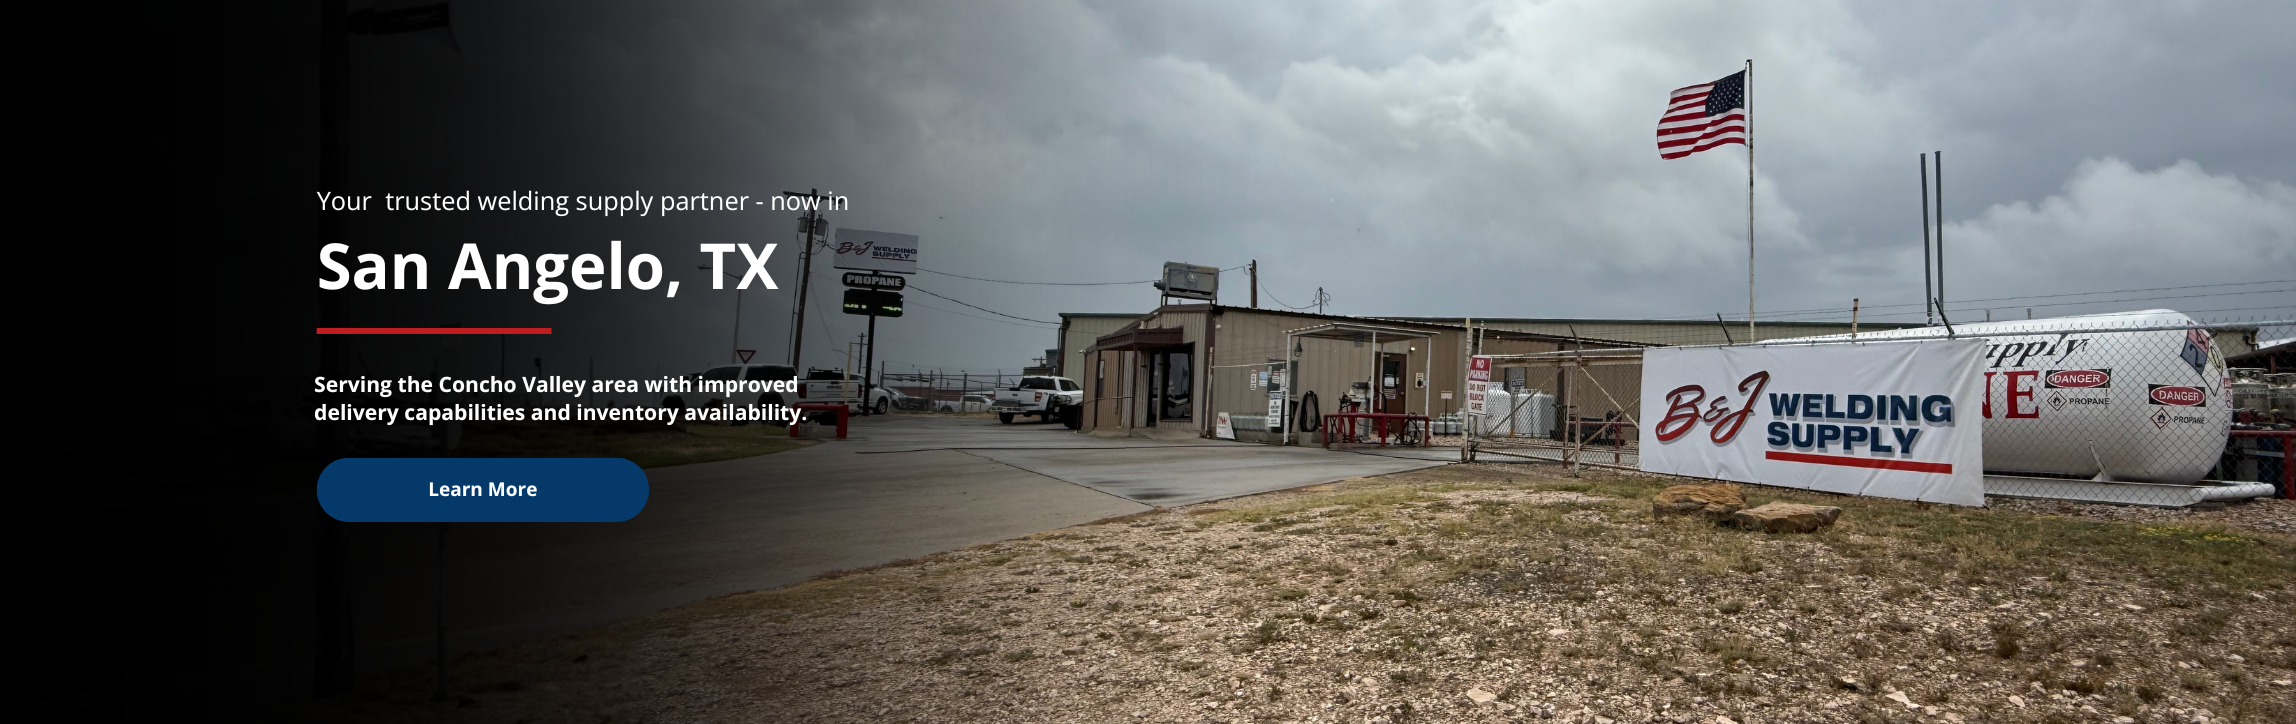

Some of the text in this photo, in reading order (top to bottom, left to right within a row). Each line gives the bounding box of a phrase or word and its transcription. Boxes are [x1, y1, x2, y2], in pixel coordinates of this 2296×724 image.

[836, 241, 874, 255] B&J
[872, 250, 910, 259] SUPPLY
[846, 274, 901, 287] PROPANE
[1475, 360, 1485, 369] NO
[2053, 374, 2101, 384] DANGER
[1469, 393, 1485, 401] BLOCK
[2069, 397, 2110, 405] PROPANE
[2159, 390, 2200, 402] DANGER
[1655, 370, 1955, 445] B&J WELDING
[2173, 416, 2205, 425] PROPANE
[1767, 421, 1923, 458] SUPPLY
